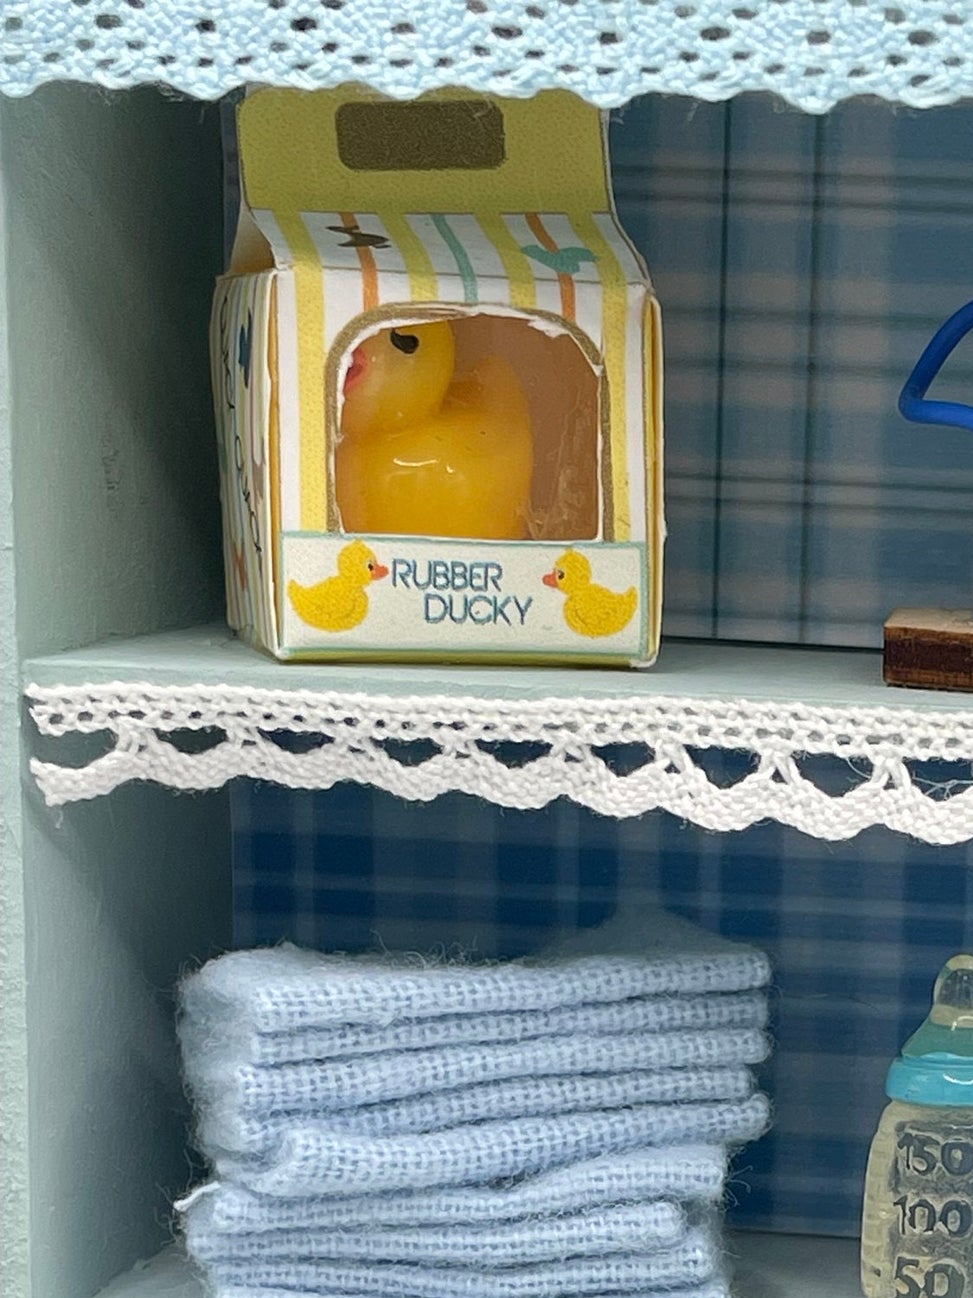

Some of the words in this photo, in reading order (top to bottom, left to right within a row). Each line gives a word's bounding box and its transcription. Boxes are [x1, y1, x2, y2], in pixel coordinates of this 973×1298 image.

[391, 558, 504, 592] RUBBER
[424, 594, 533, 627] DUCKY
[893, 1194, 973, 1239] 100
